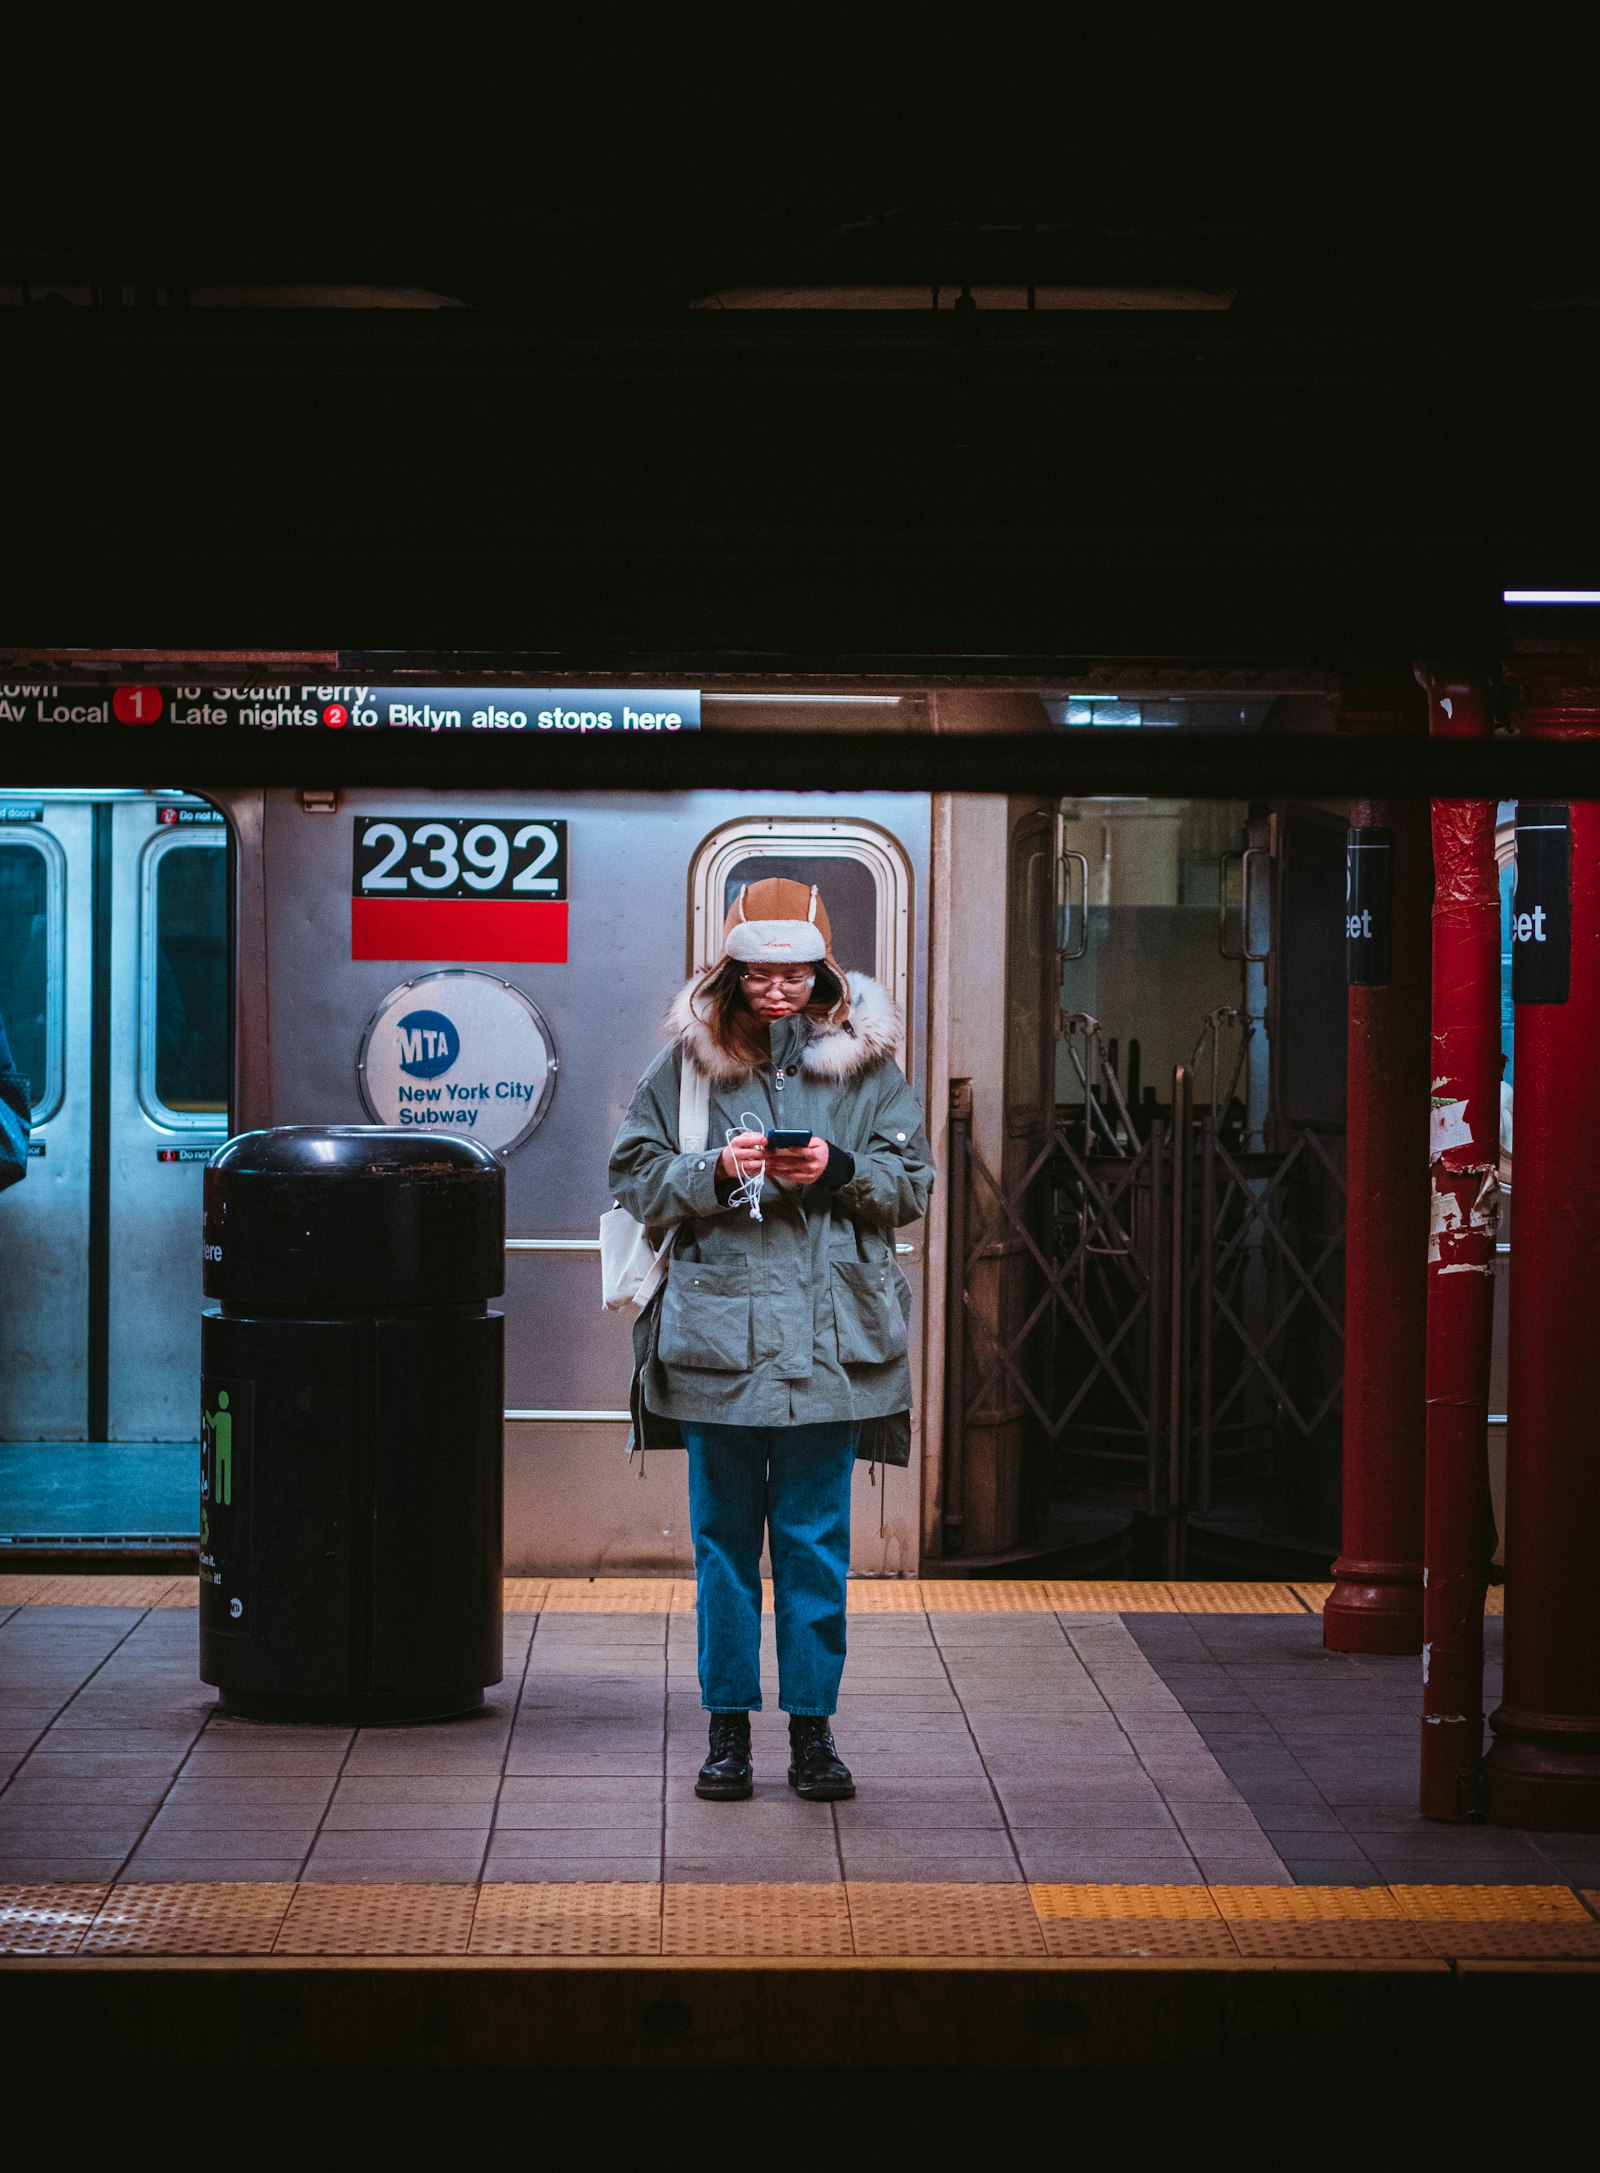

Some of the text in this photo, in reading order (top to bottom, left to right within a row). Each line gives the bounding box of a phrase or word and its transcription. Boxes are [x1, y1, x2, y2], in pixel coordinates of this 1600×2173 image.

[0, 684, 58, 698] own
[129, 690, 142, 718] 1
[37, 701, 108, 723] Local
[170, 702, 682, 733] Late nights 2 to Bklyn also stops here
[362, 823, 559, 890] 2392
[1346, 909, 1372, 938] et
[1513, 905, 1547, 942] et
[398, 1026, 448, 1064] MTA
[399, 1081, 534, 1102] New York City
[400, 1107, 478, 1127] Subway
